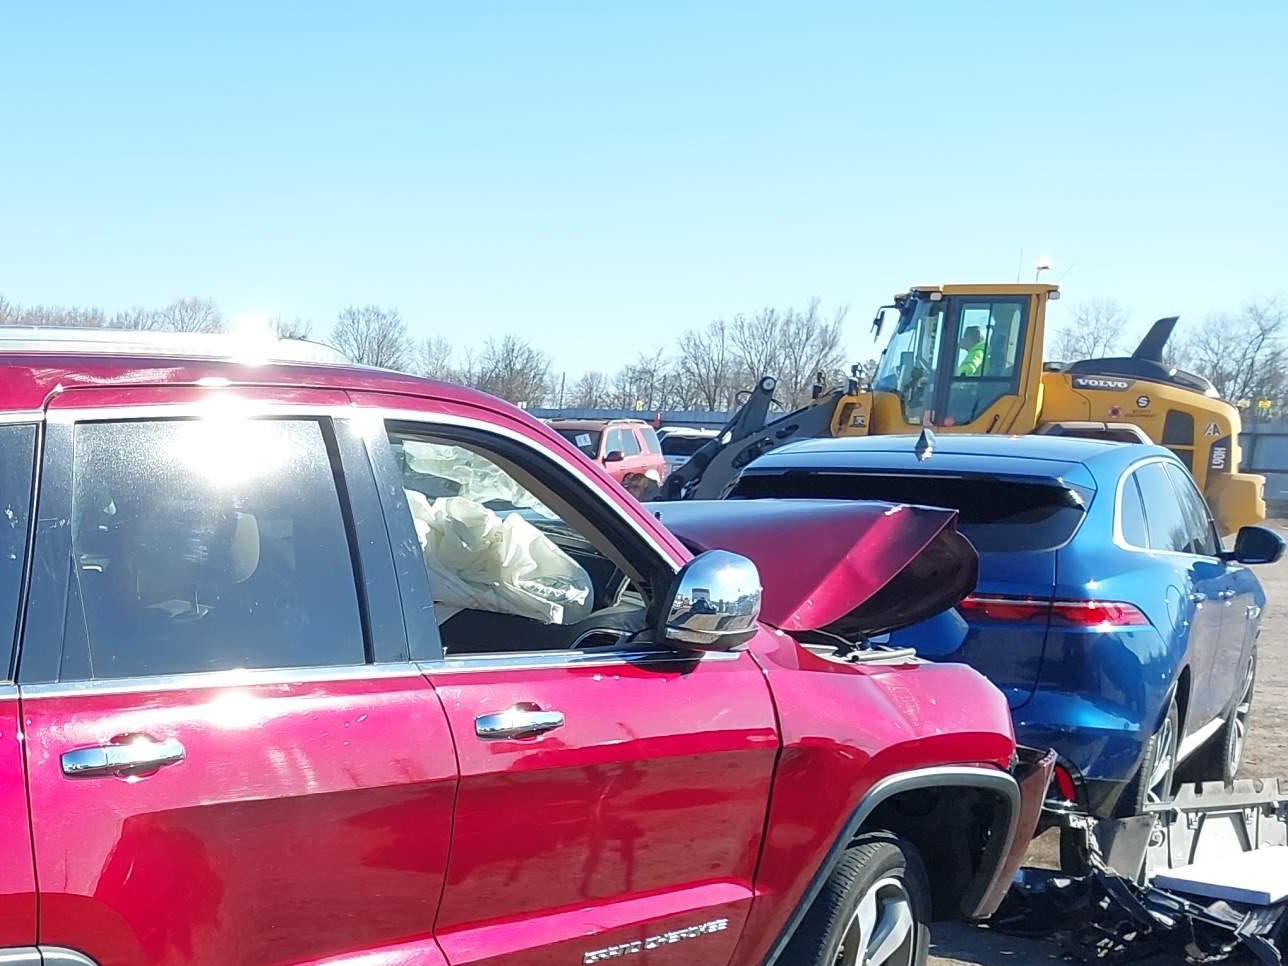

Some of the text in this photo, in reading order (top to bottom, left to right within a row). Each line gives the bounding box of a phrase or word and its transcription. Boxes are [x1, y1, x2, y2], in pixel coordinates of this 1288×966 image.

[1077, 378, 1128, 389] VOLVO
[1212, 446, 1228, 469] L90H
[583, 918, 729, 964] GRAND CHEROKEE
